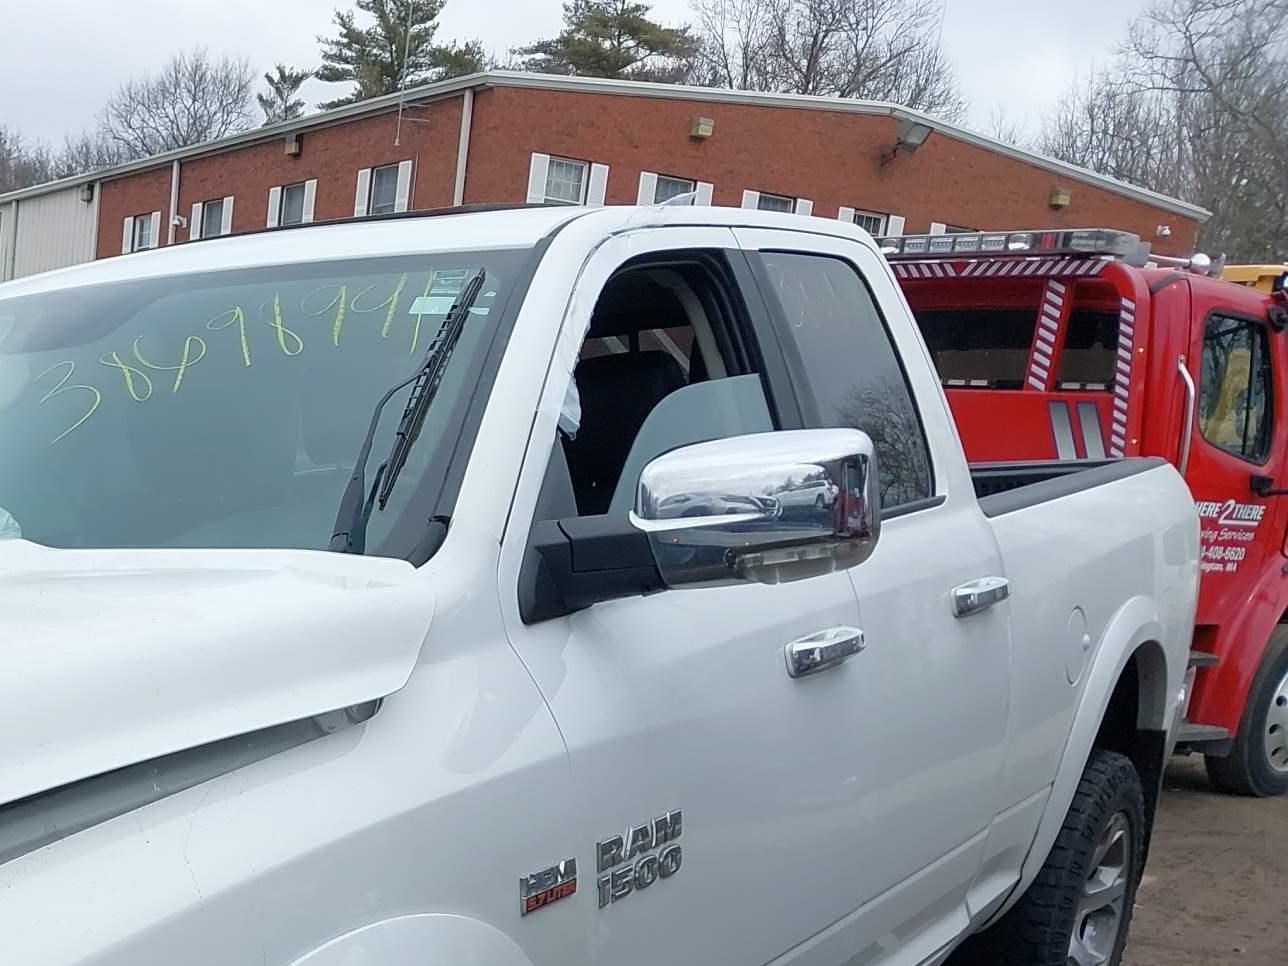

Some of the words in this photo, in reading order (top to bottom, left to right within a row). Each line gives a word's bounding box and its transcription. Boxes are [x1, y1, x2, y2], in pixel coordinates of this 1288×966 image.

[1218, 528, 1256, 541] Services
[596, 808, 682, 873] RAM
[597, 843, 683, 910] 1500
